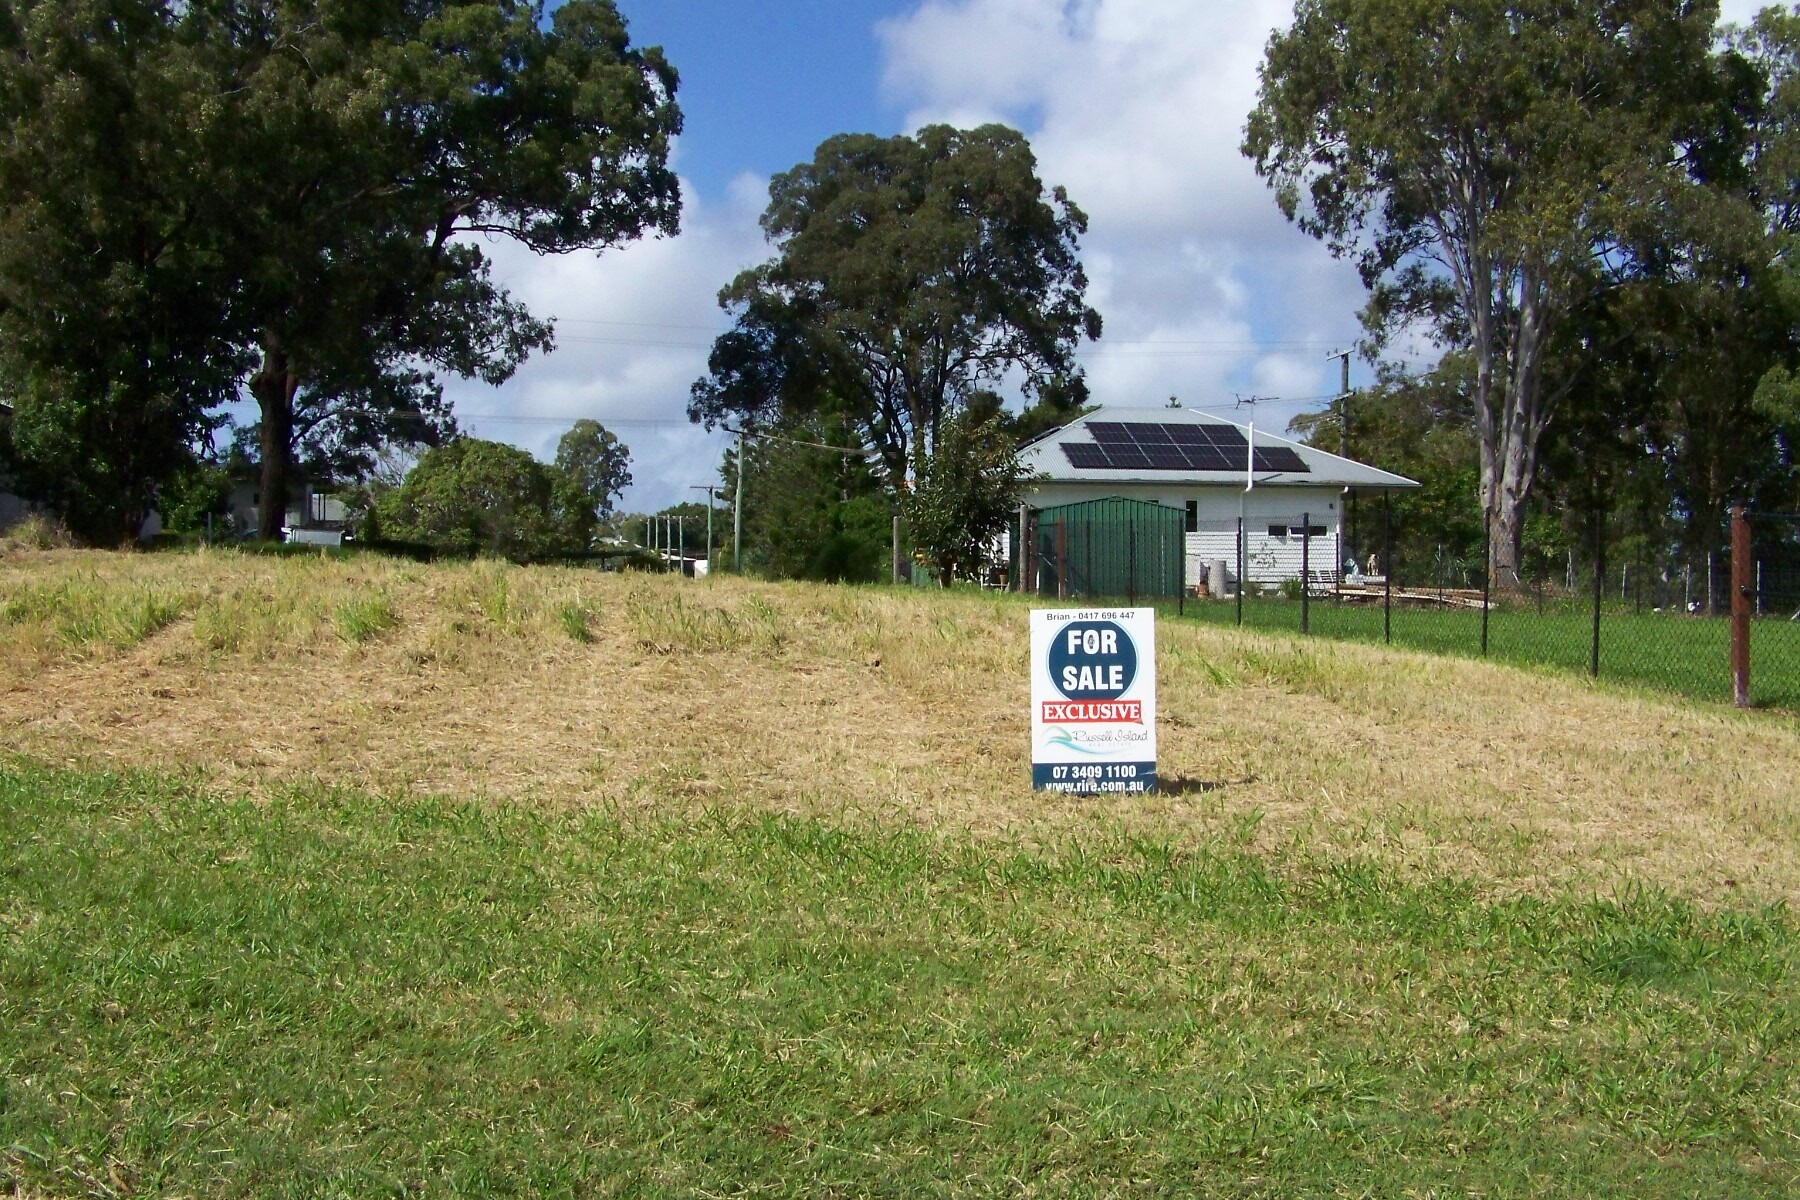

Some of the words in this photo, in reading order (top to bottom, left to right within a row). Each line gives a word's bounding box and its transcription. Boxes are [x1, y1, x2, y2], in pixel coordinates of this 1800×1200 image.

[1046, 613, 1070, 621] Brian
[1078, 612, 1099, 620] 0417
[1119, 611, 1135, 619] 447
[1067, 629, 1118, 655] FOR
[1062, 665, 1123, 691] SALE
[1043, 703, 1141, 720] EXCLUSIVE
[1072, 730, 1112, 742] Russell
[1114, 729, 1148, 742] Island
[1052, 766, 1068, 779] 07
[1071, 765, 1102, 778] 3409
[1106, 765, 1137, 777] 1100
